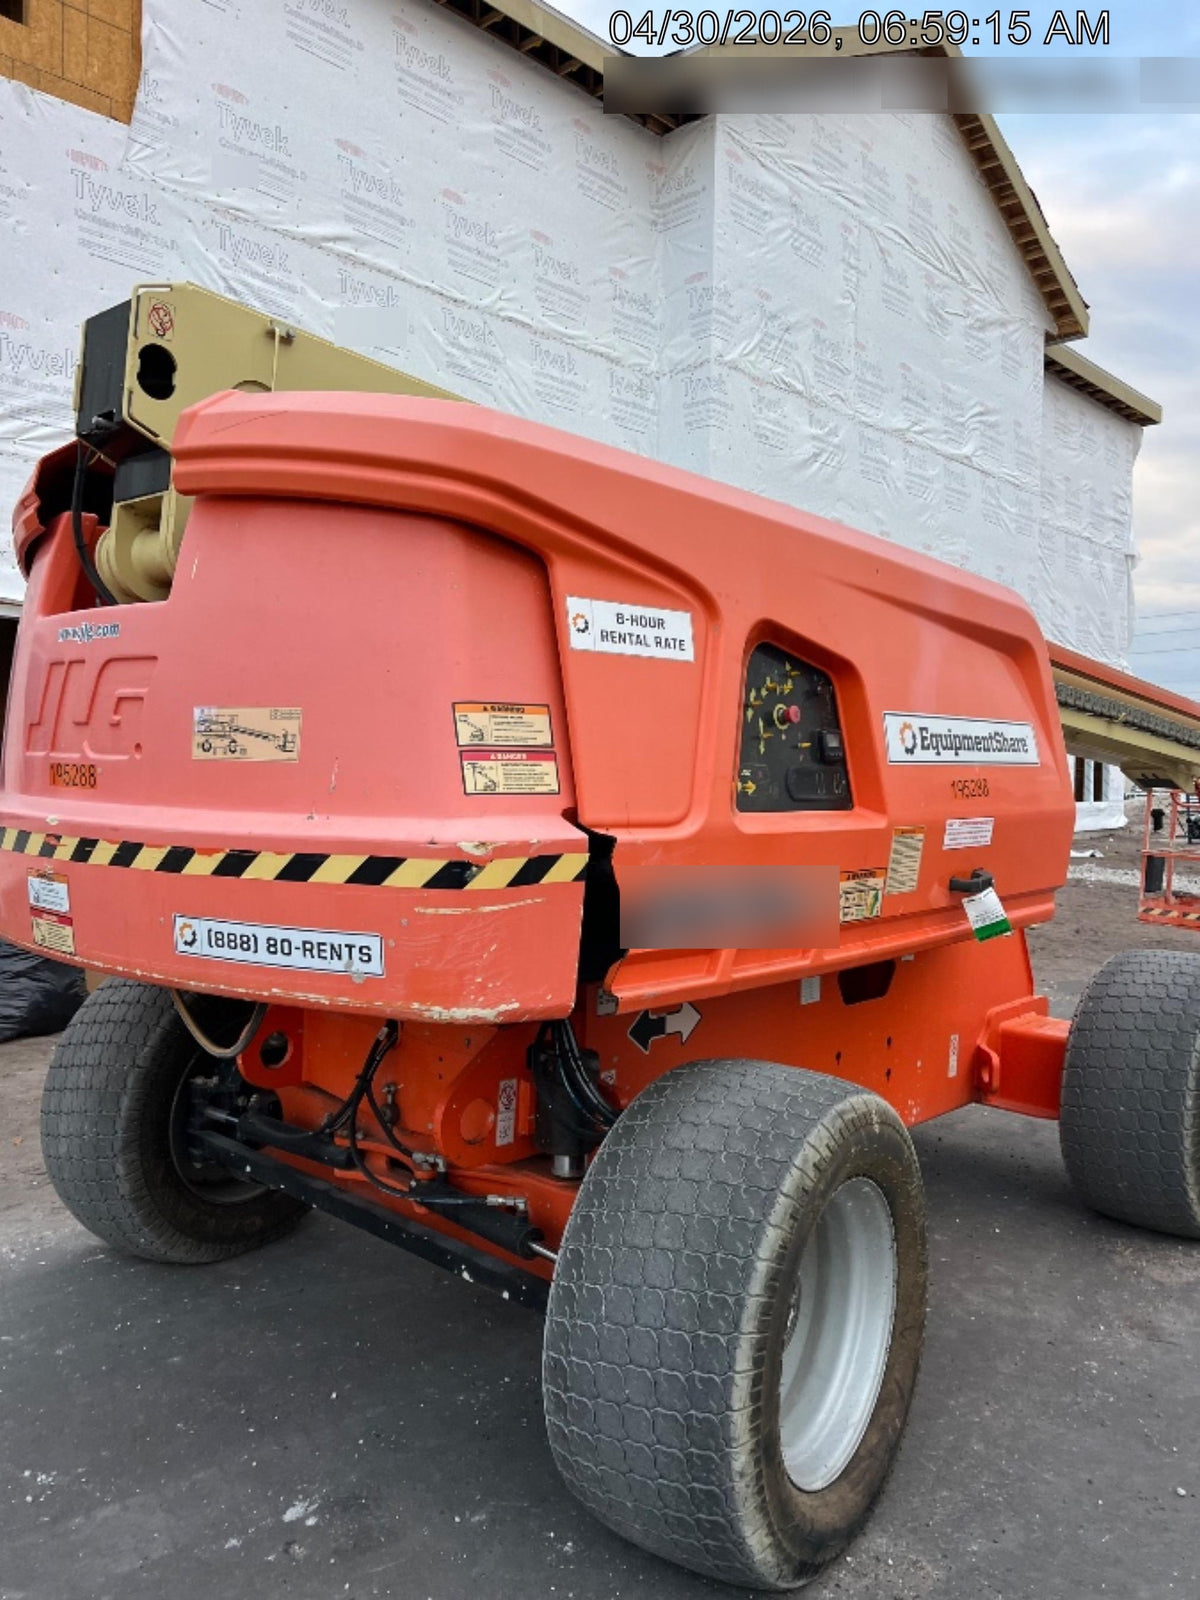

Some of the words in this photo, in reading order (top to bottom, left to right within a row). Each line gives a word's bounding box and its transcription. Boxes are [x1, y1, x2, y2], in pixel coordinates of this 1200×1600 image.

[616, 612, 666, 630] 8-HOUR
[600, 629, 651, 648] RENTAL
[654, 636, 686, 652] RATE
[918, 726, 1028, 757] EquipmentShare
[207, 927, 259, 954] (888)
[266, 936, 373, 964] 80-RENTS
